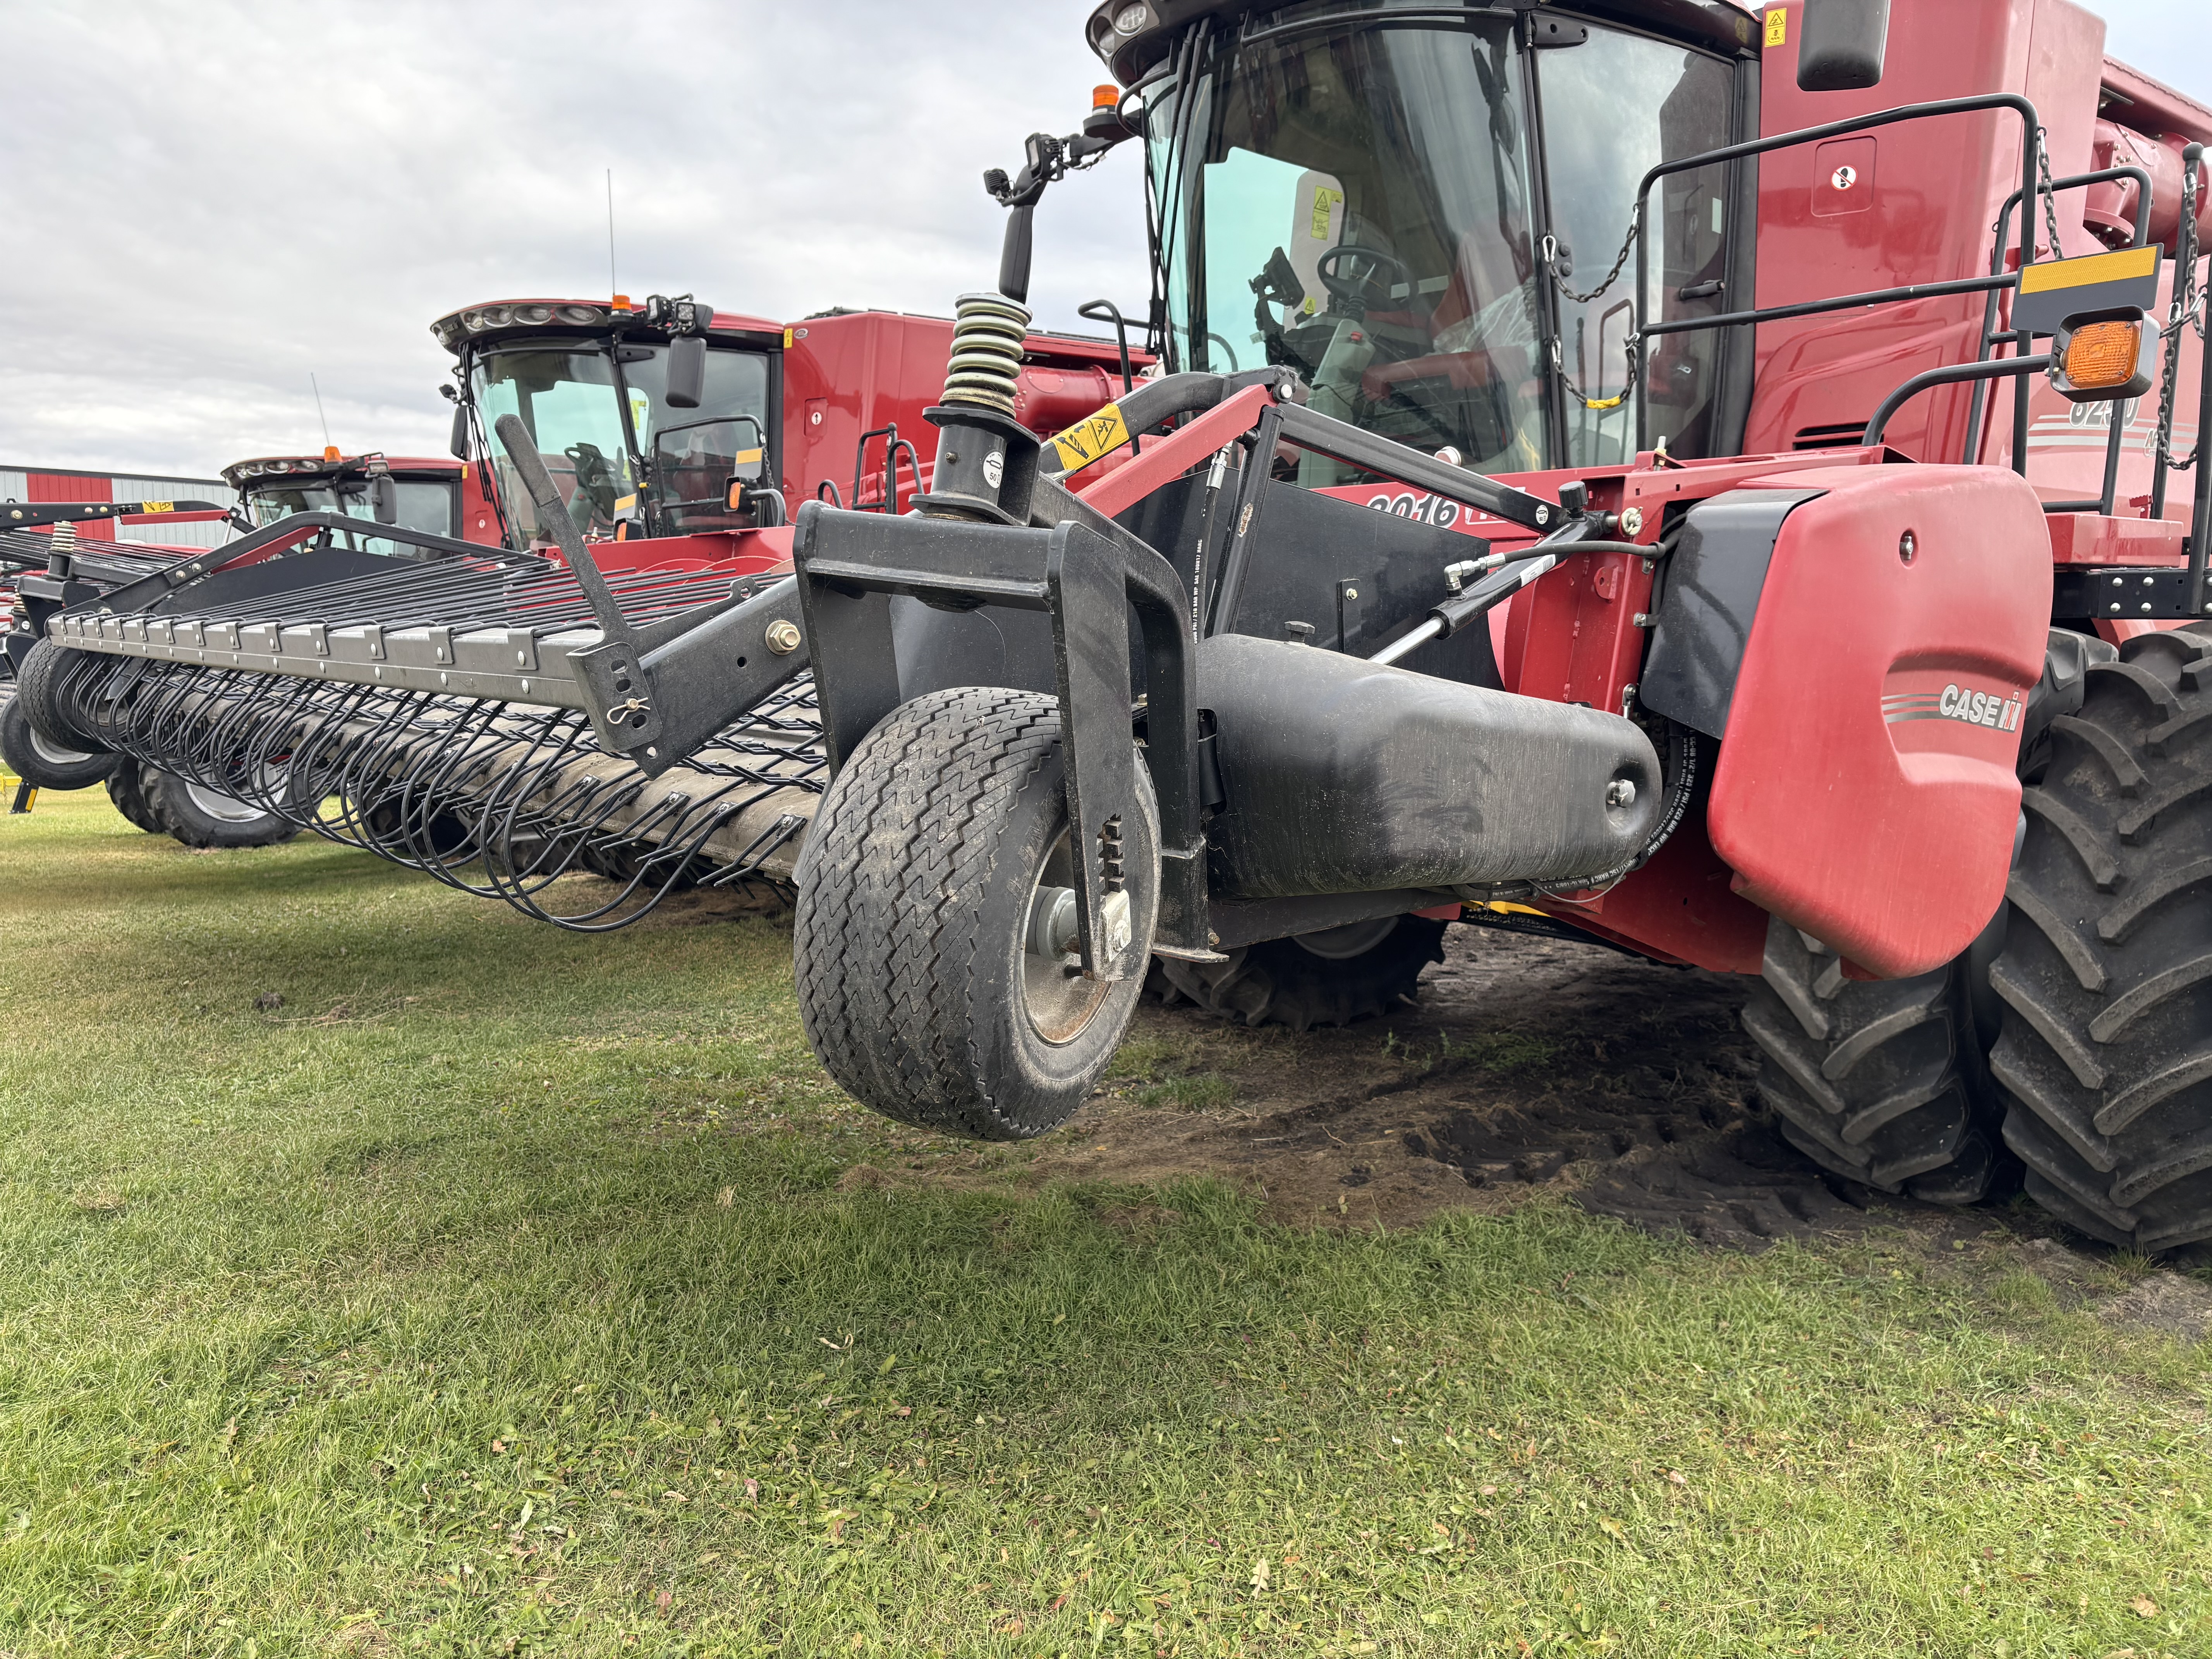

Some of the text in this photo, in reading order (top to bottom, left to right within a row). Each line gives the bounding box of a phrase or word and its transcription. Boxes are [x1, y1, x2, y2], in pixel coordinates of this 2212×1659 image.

[989, 472, 997, 481] 50
[1939, 684, 2002, 726] CASE
[1674, 808, 1684, 821] 225
